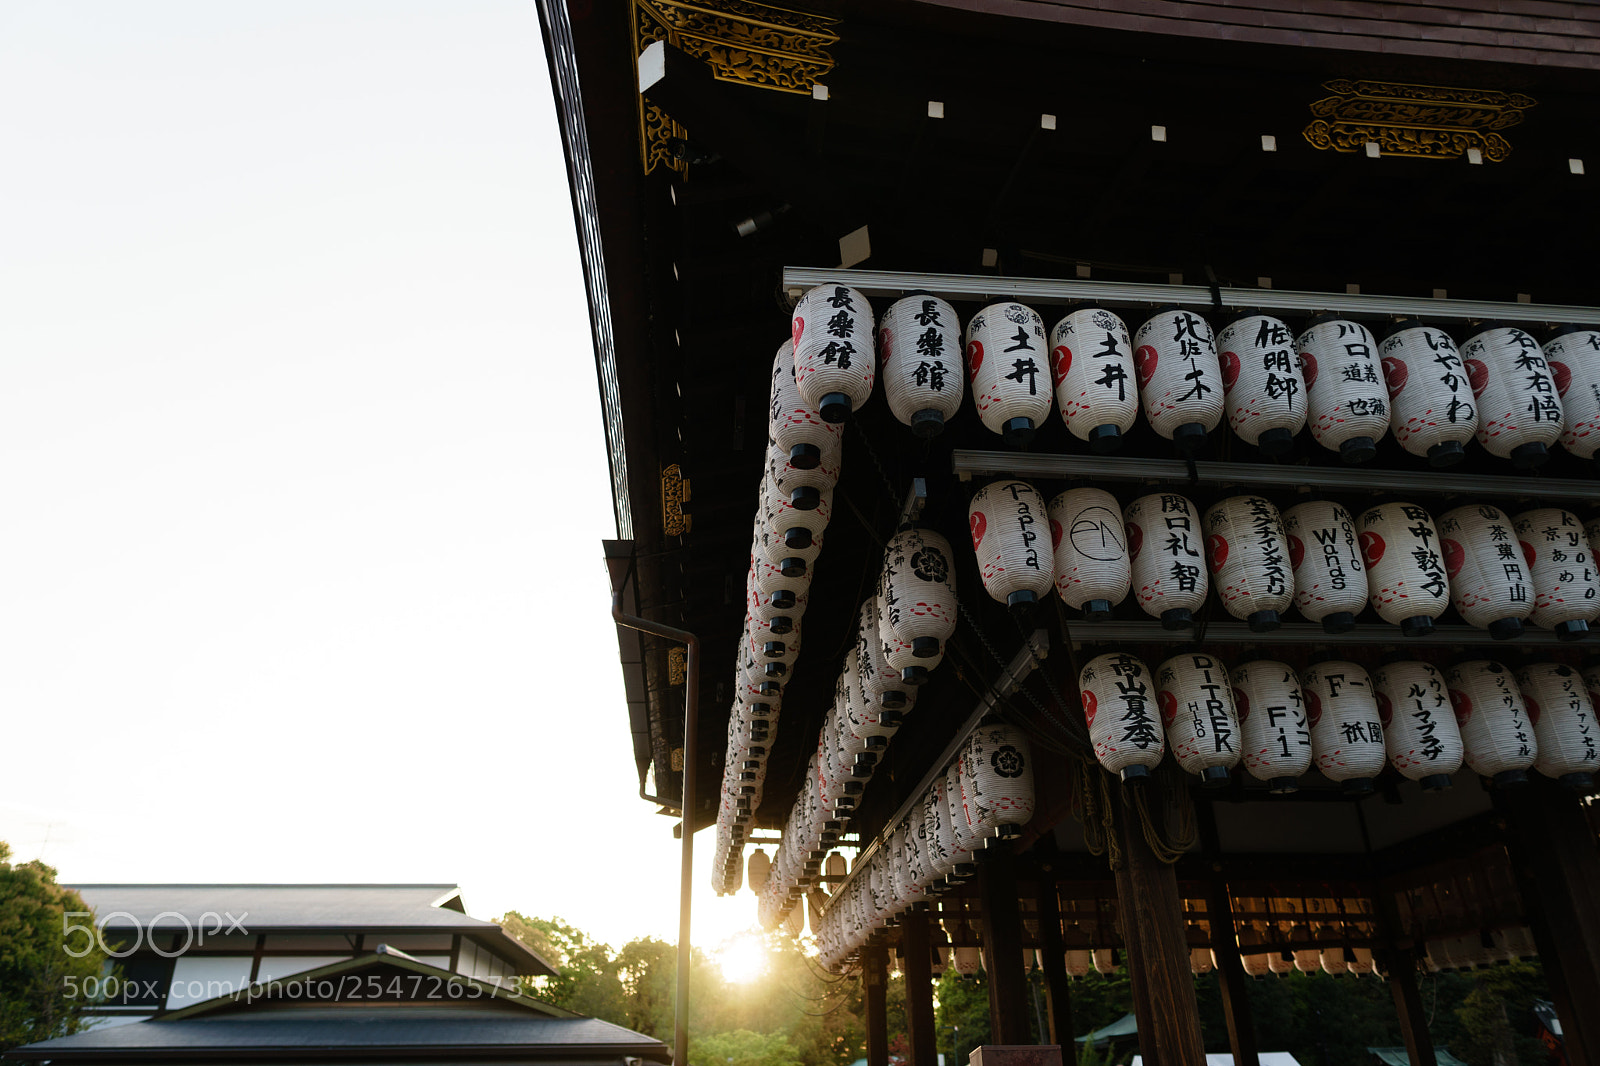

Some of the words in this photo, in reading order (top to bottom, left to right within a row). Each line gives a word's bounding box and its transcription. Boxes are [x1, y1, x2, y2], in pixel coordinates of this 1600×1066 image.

[1003, 325, 1040, 396] 土井
[1092, 331, 1128, 402] 土井
[1337, 324, 1371, 360] 川口
[1424, 331, 1474, 423] はやかわ
[1161, 495, 1199, 592] 関口礼智
[1400, 506, 1446, 598] 田中敦子
[1188, 701, 1206, 738] HIRO
